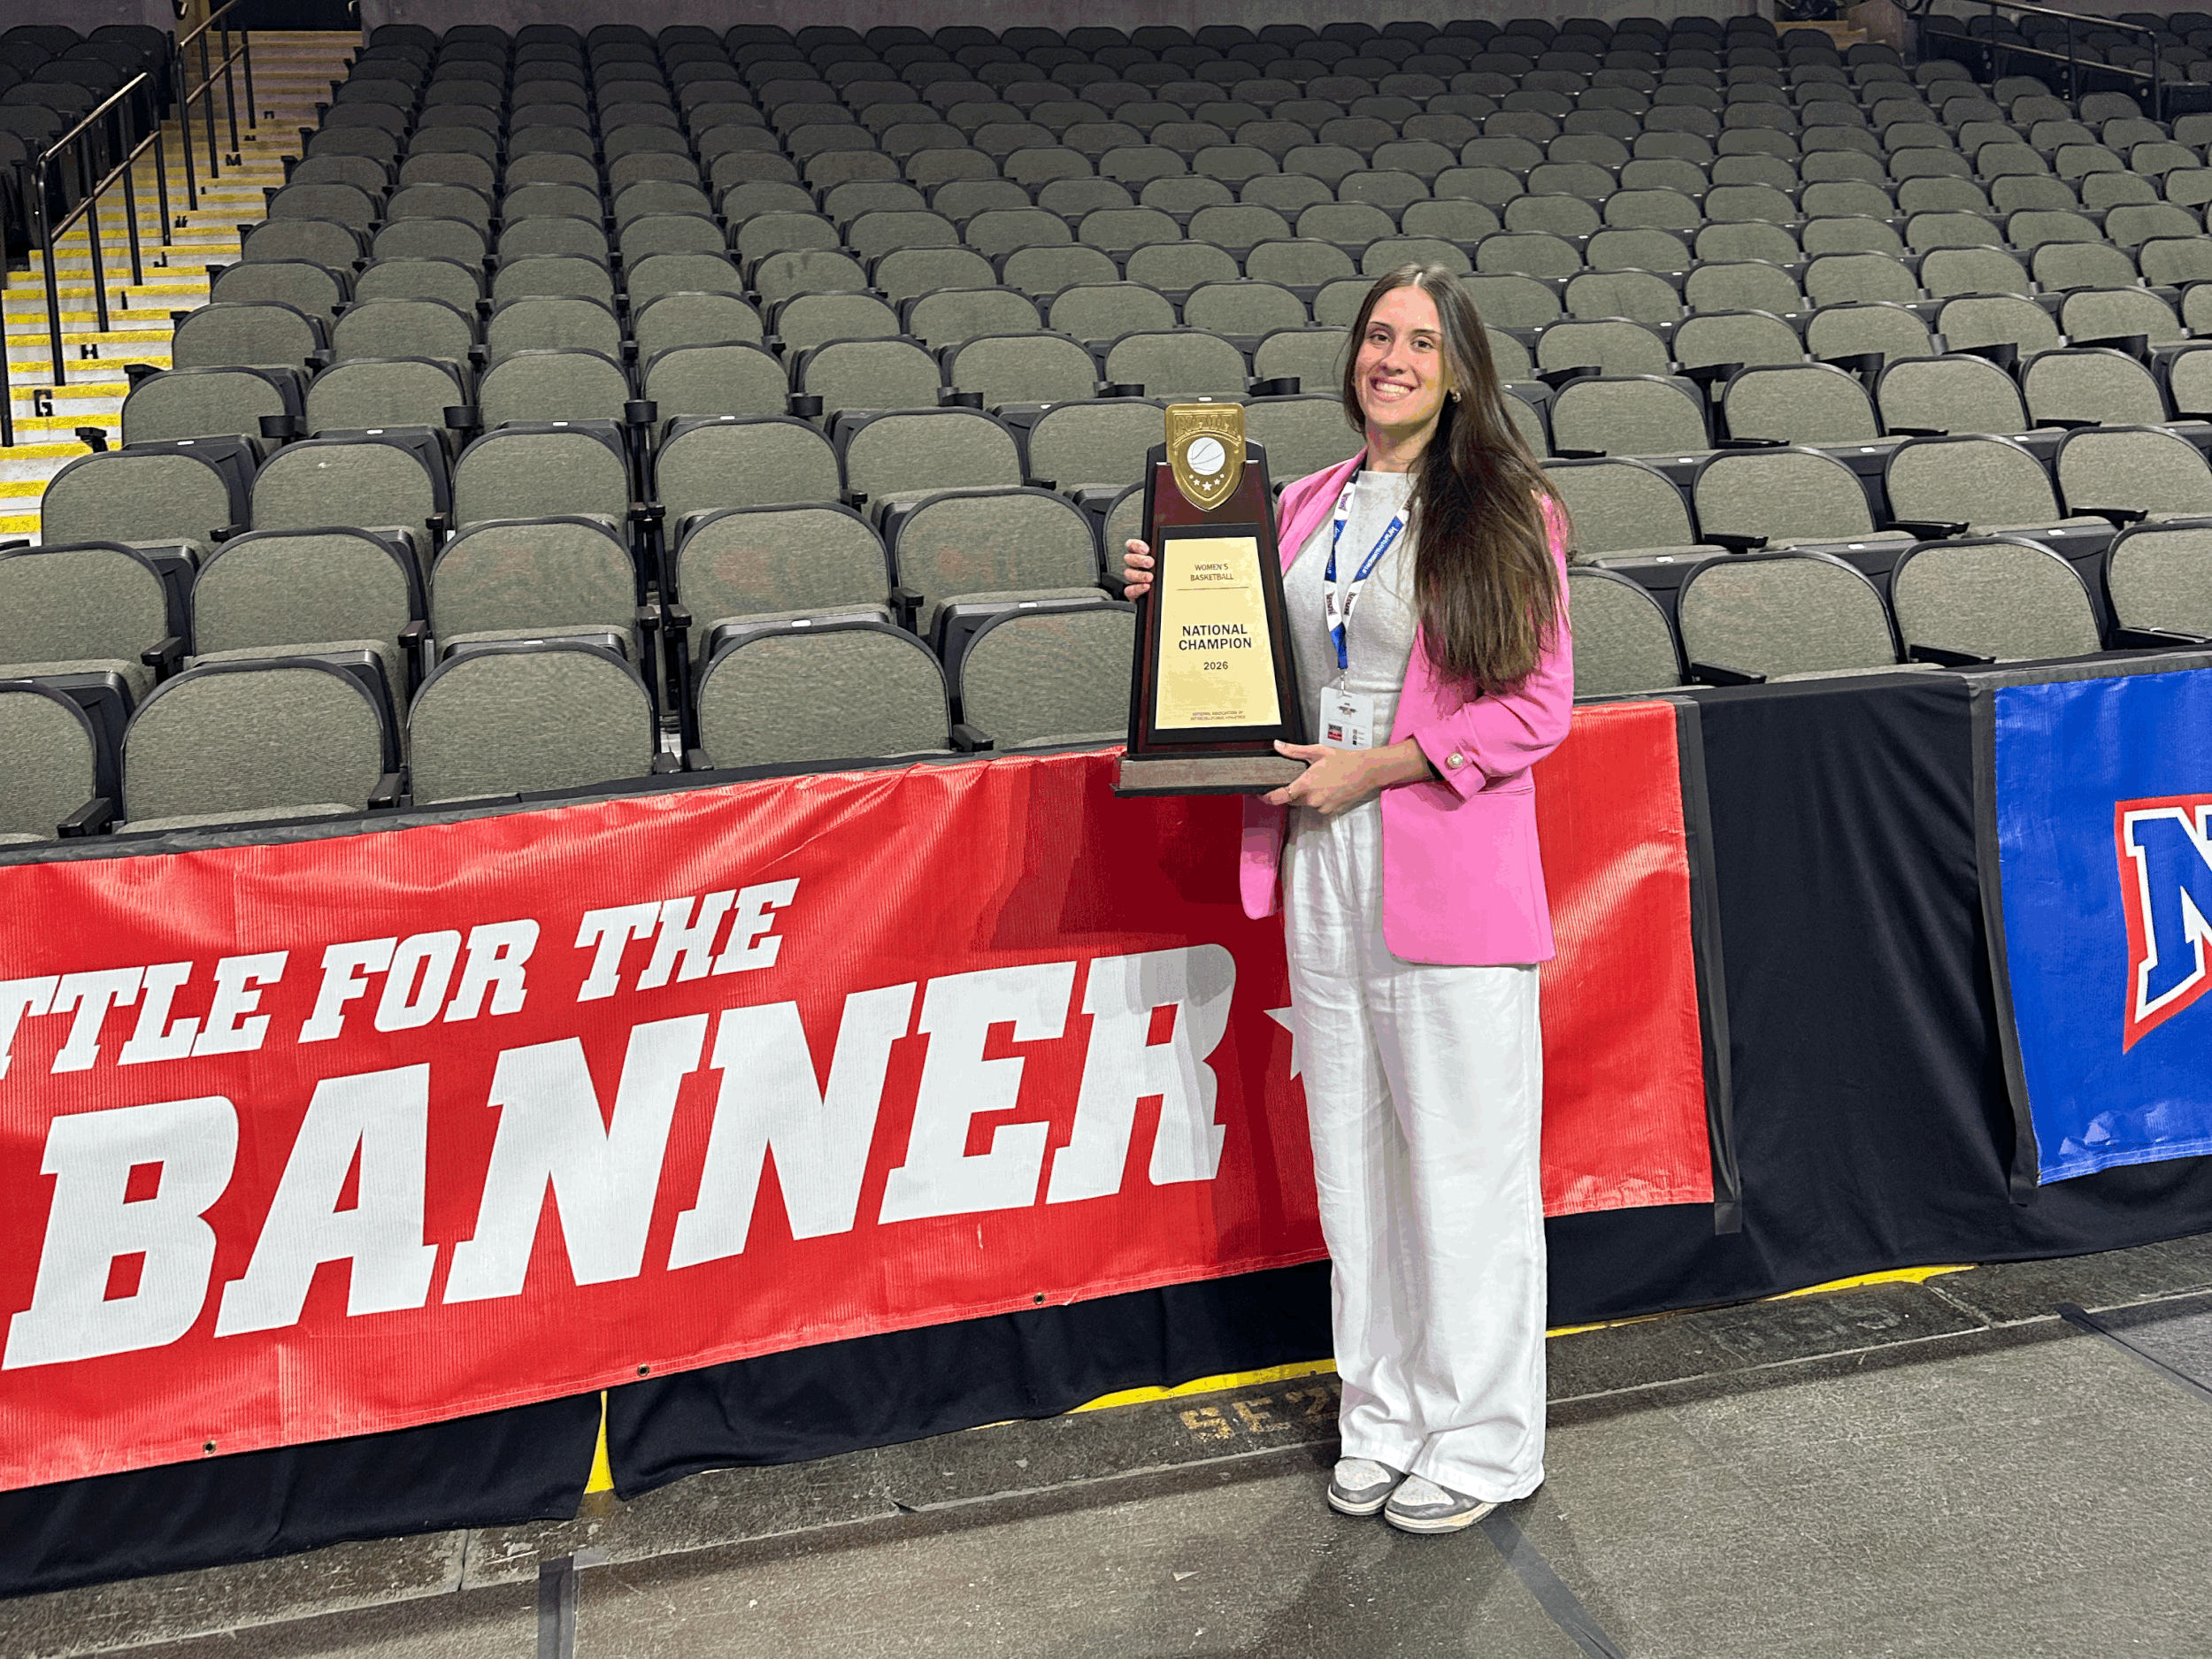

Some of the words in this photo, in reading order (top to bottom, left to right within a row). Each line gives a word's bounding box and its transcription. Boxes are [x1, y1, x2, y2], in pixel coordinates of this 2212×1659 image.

[81, 343, 99, 359] H
[34, 389, 54, 417] G
[1182, 624, 1248, 636] NATIONAL
[1179, 637, 1252, 650] CHAMPION
[1203, 661, 1229, 670] 2026
[299, 918, 541, 1044] FOR
[575, 877, 801, 1003] THE
[2, 942, 1237, 1371] BANNER
